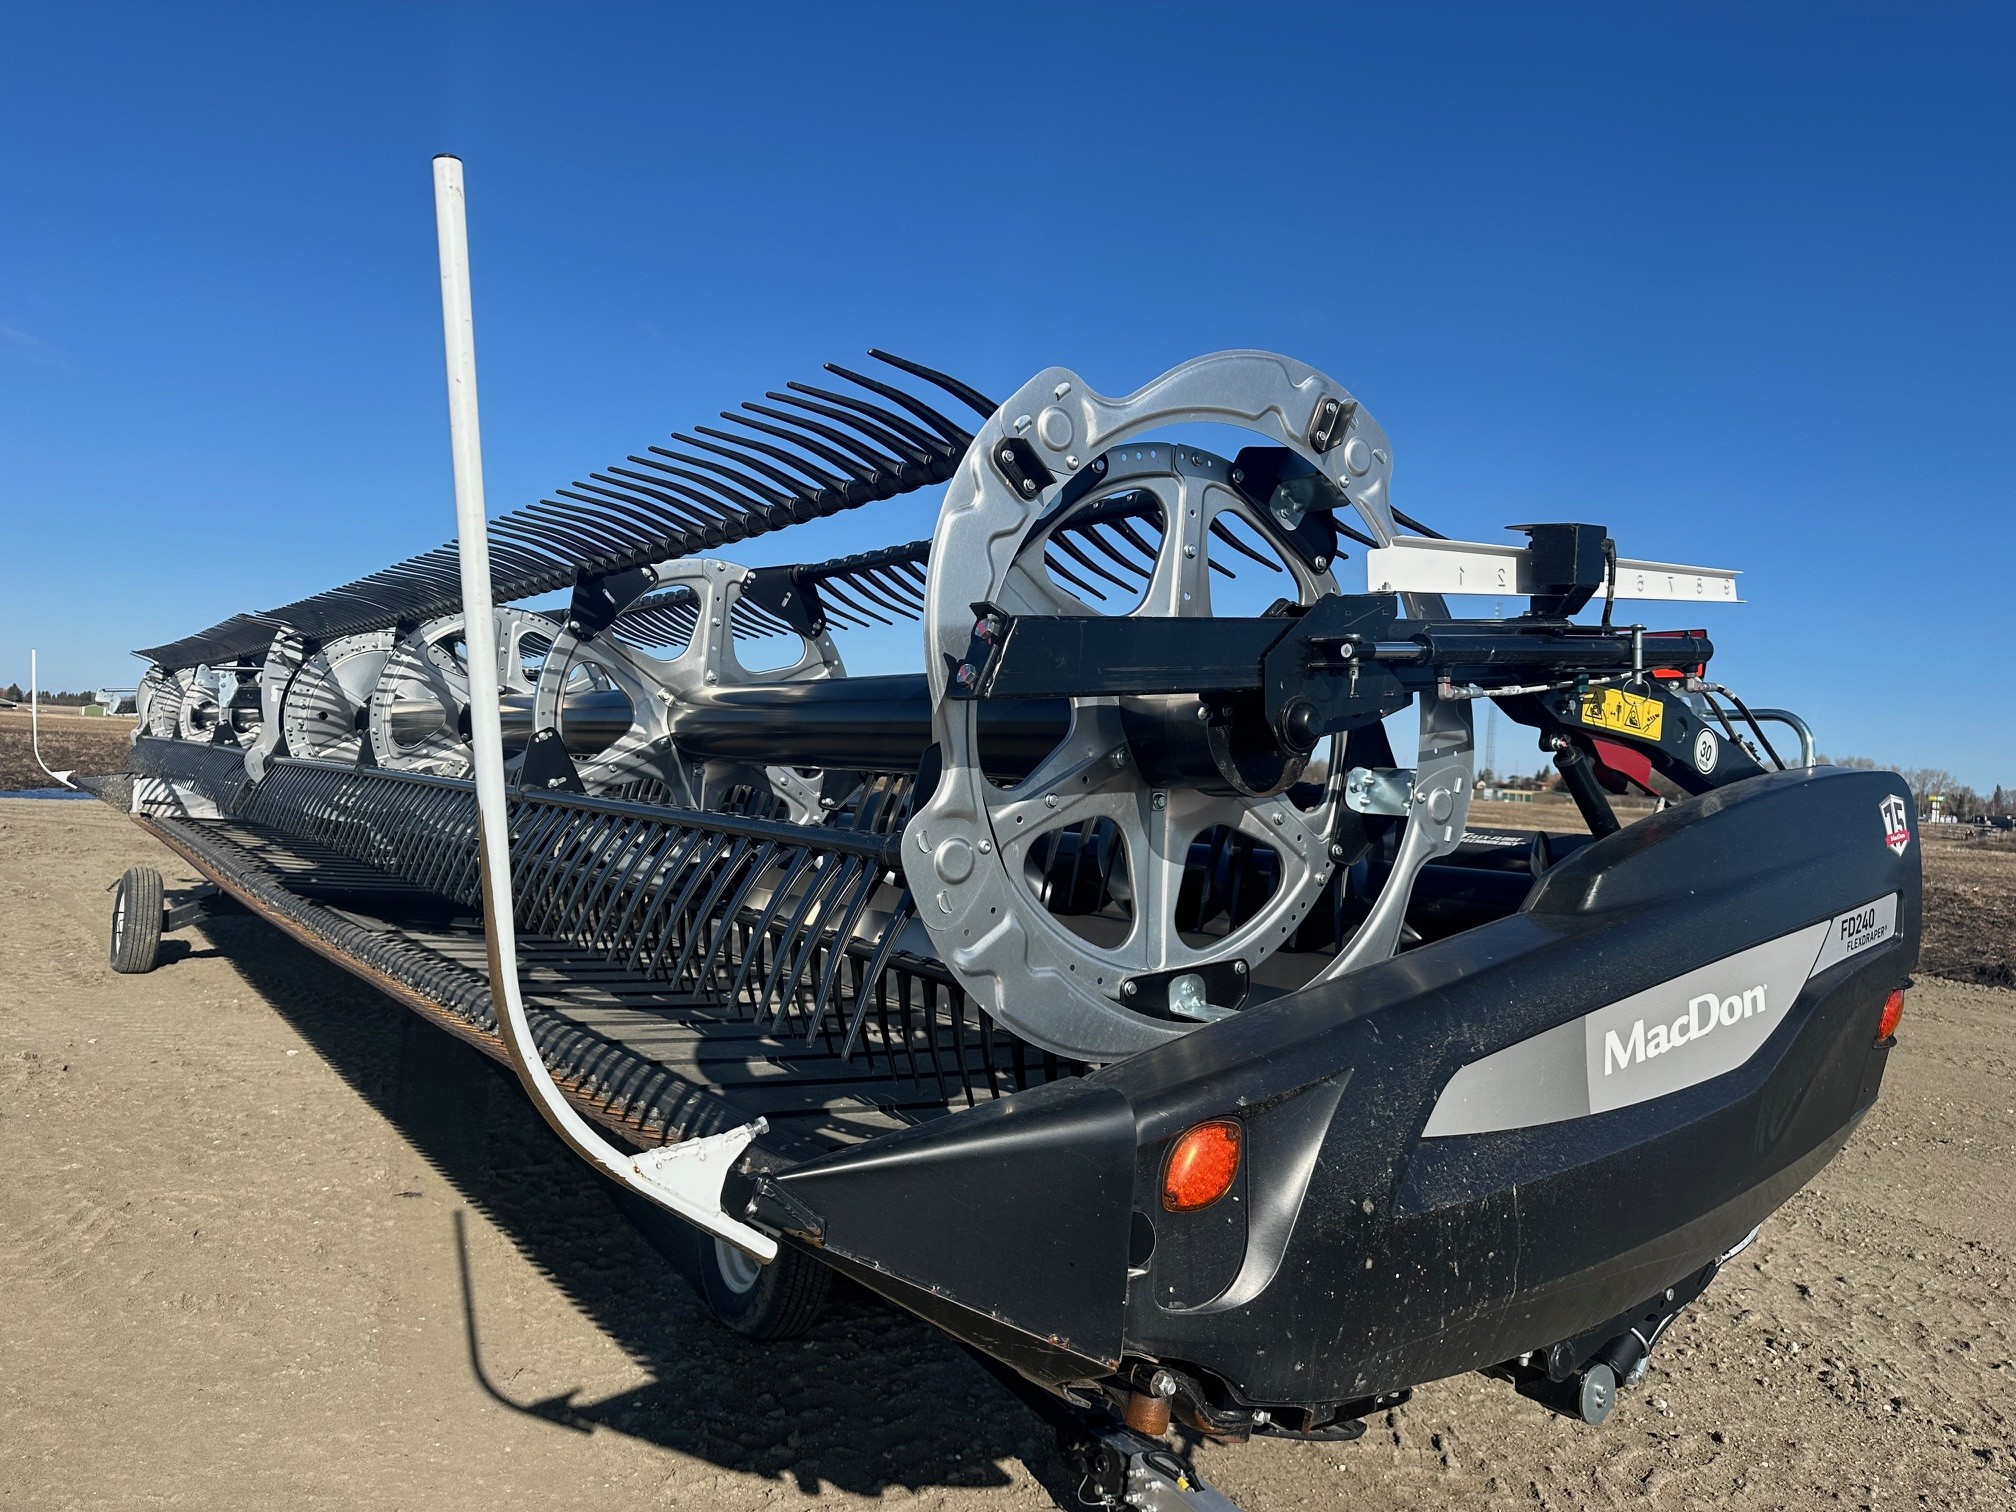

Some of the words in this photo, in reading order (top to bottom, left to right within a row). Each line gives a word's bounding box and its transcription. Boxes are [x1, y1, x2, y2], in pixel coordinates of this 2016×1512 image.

[1700, 740, 1712, 762] 30
[1882, 801, 1905, 842] 75
[1840, 907, 1876, 941] FD240
[1604, 984, 1767, 1077] MacDon
